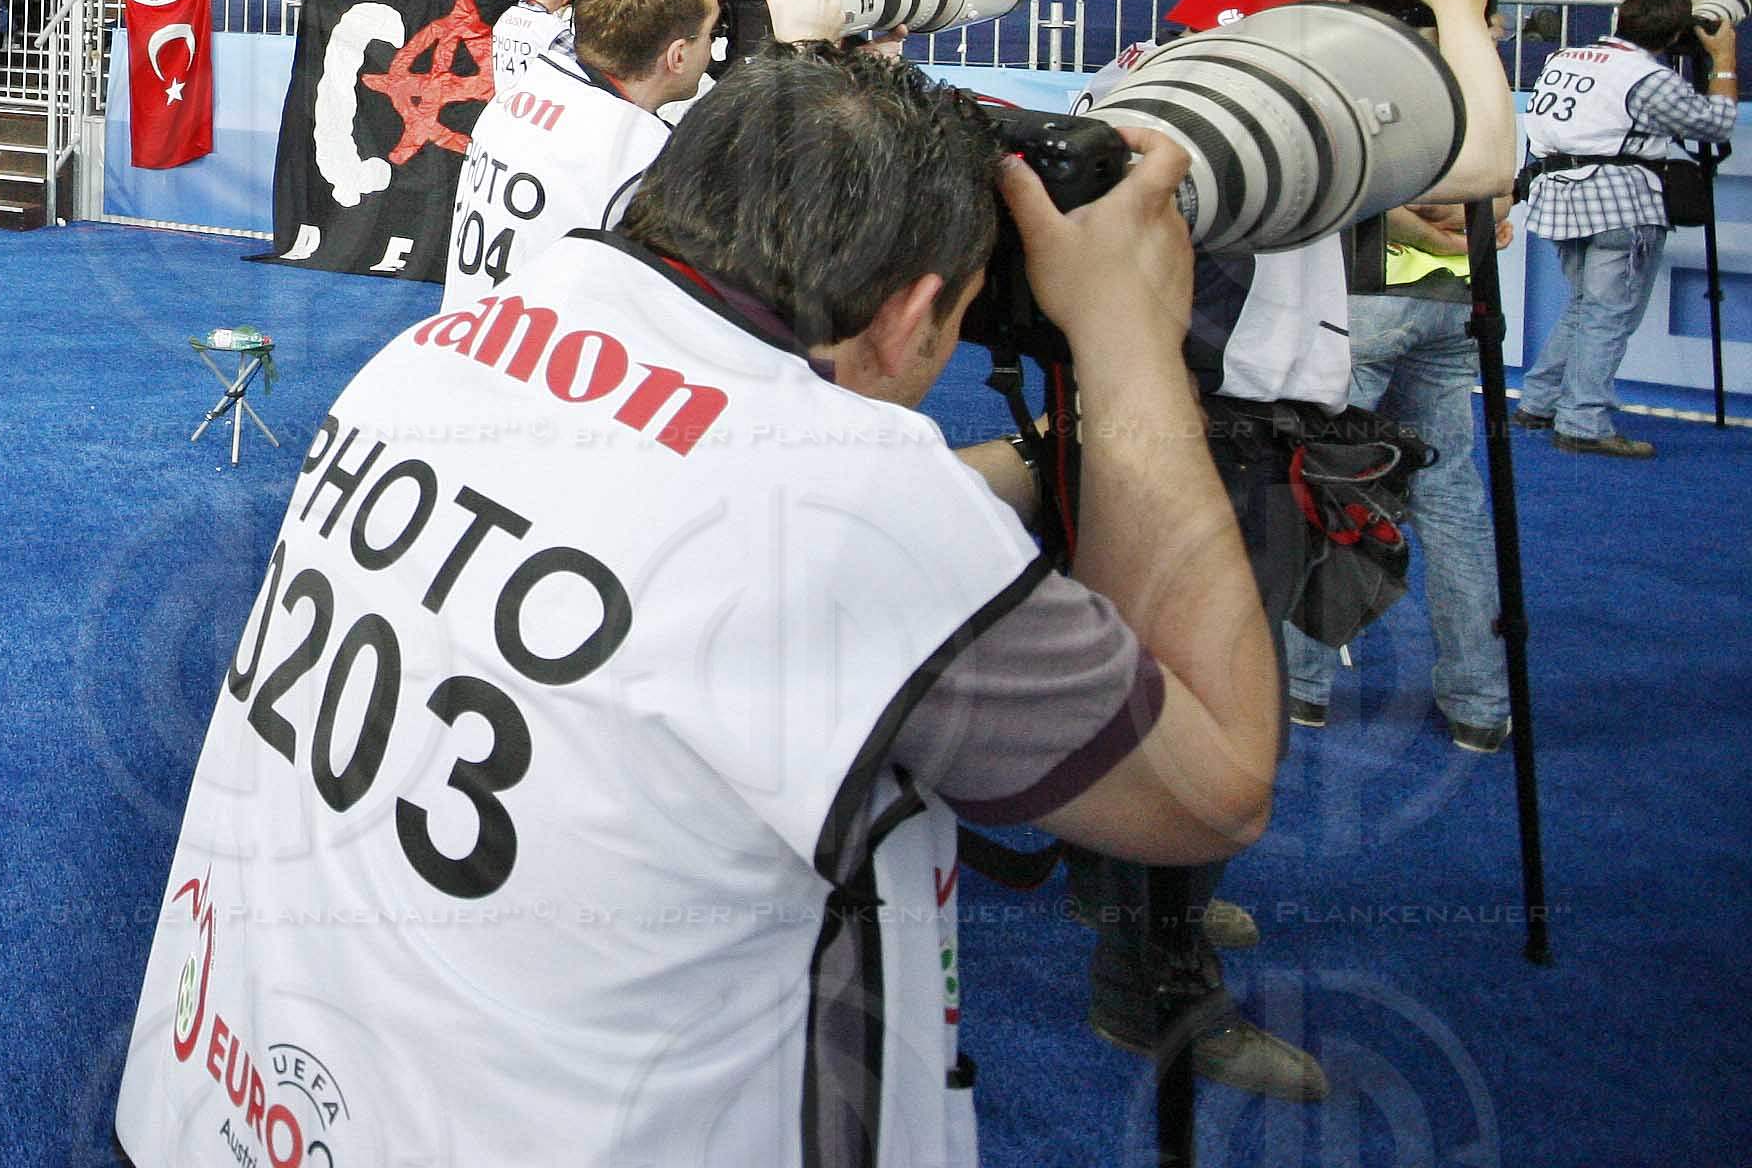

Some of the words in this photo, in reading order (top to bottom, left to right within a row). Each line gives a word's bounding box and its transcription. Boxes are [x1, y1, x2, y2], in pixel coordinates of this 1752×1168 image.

[1543, 69, 1596, 94] OTO
[413, 294, 730, 458] anon
[301, 414, 634, 687] PHOTO
[227, 538, 534, 900] 0203
[205, 1014, 303, 1168] EURO
[272, 1053, 340, 1127] UEFA
